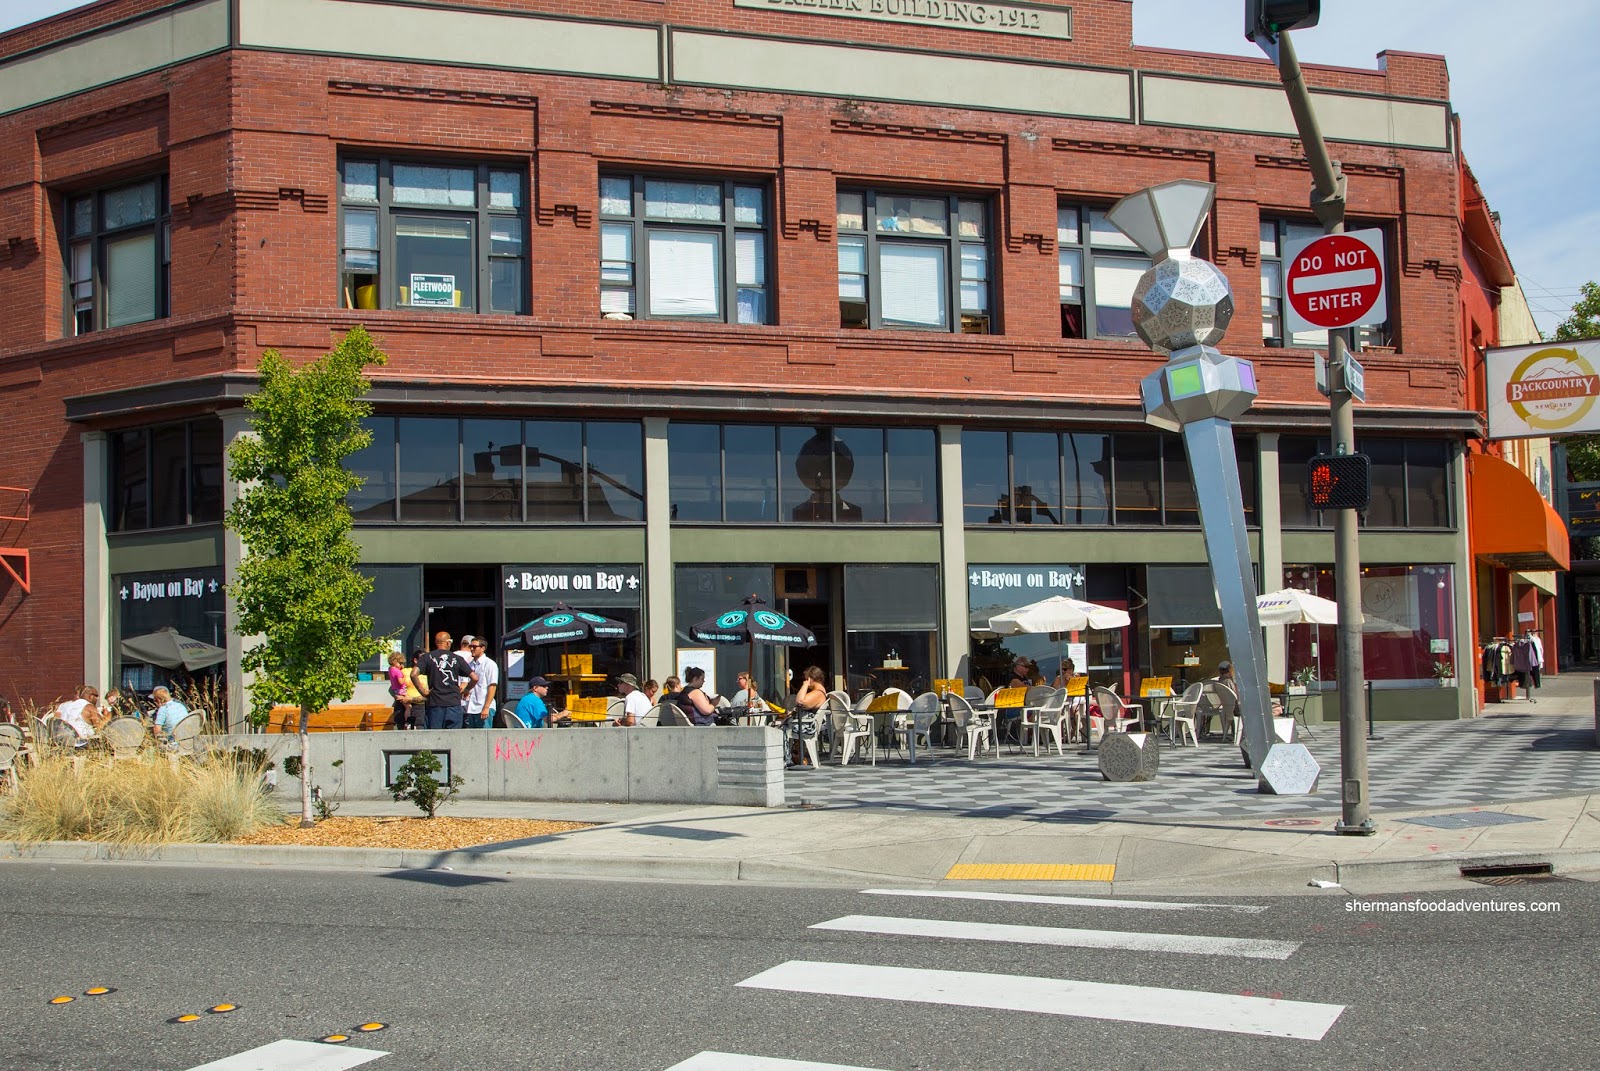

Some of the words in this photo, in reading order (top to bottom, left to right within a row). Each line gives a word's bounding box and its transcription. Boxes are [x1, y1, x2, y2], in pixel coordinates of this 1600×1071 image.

[1300, 255, 1323, 272] DO
[1334, 249, 1367, 268] NOT
[413, 282, 452, 292] FLEETWOOD
[1308, 291, 1363, 312] ENTER
[1511, 377, 1594, 401] BACKCOUNTRY
[133, 581, 166, 602] Bayou
[167, 581, 181, 597] on
[184, 577, 204, 598] Bay
[521, 572, 569, 593] Bayou
[572, 574, 592, 590] on
[596, 571, 625, 593] Bay
[981, 570, 1022, 590] Bayou
[1026, 572, 1044, 588] on
[1048, 570, 1073, 590] Bay
